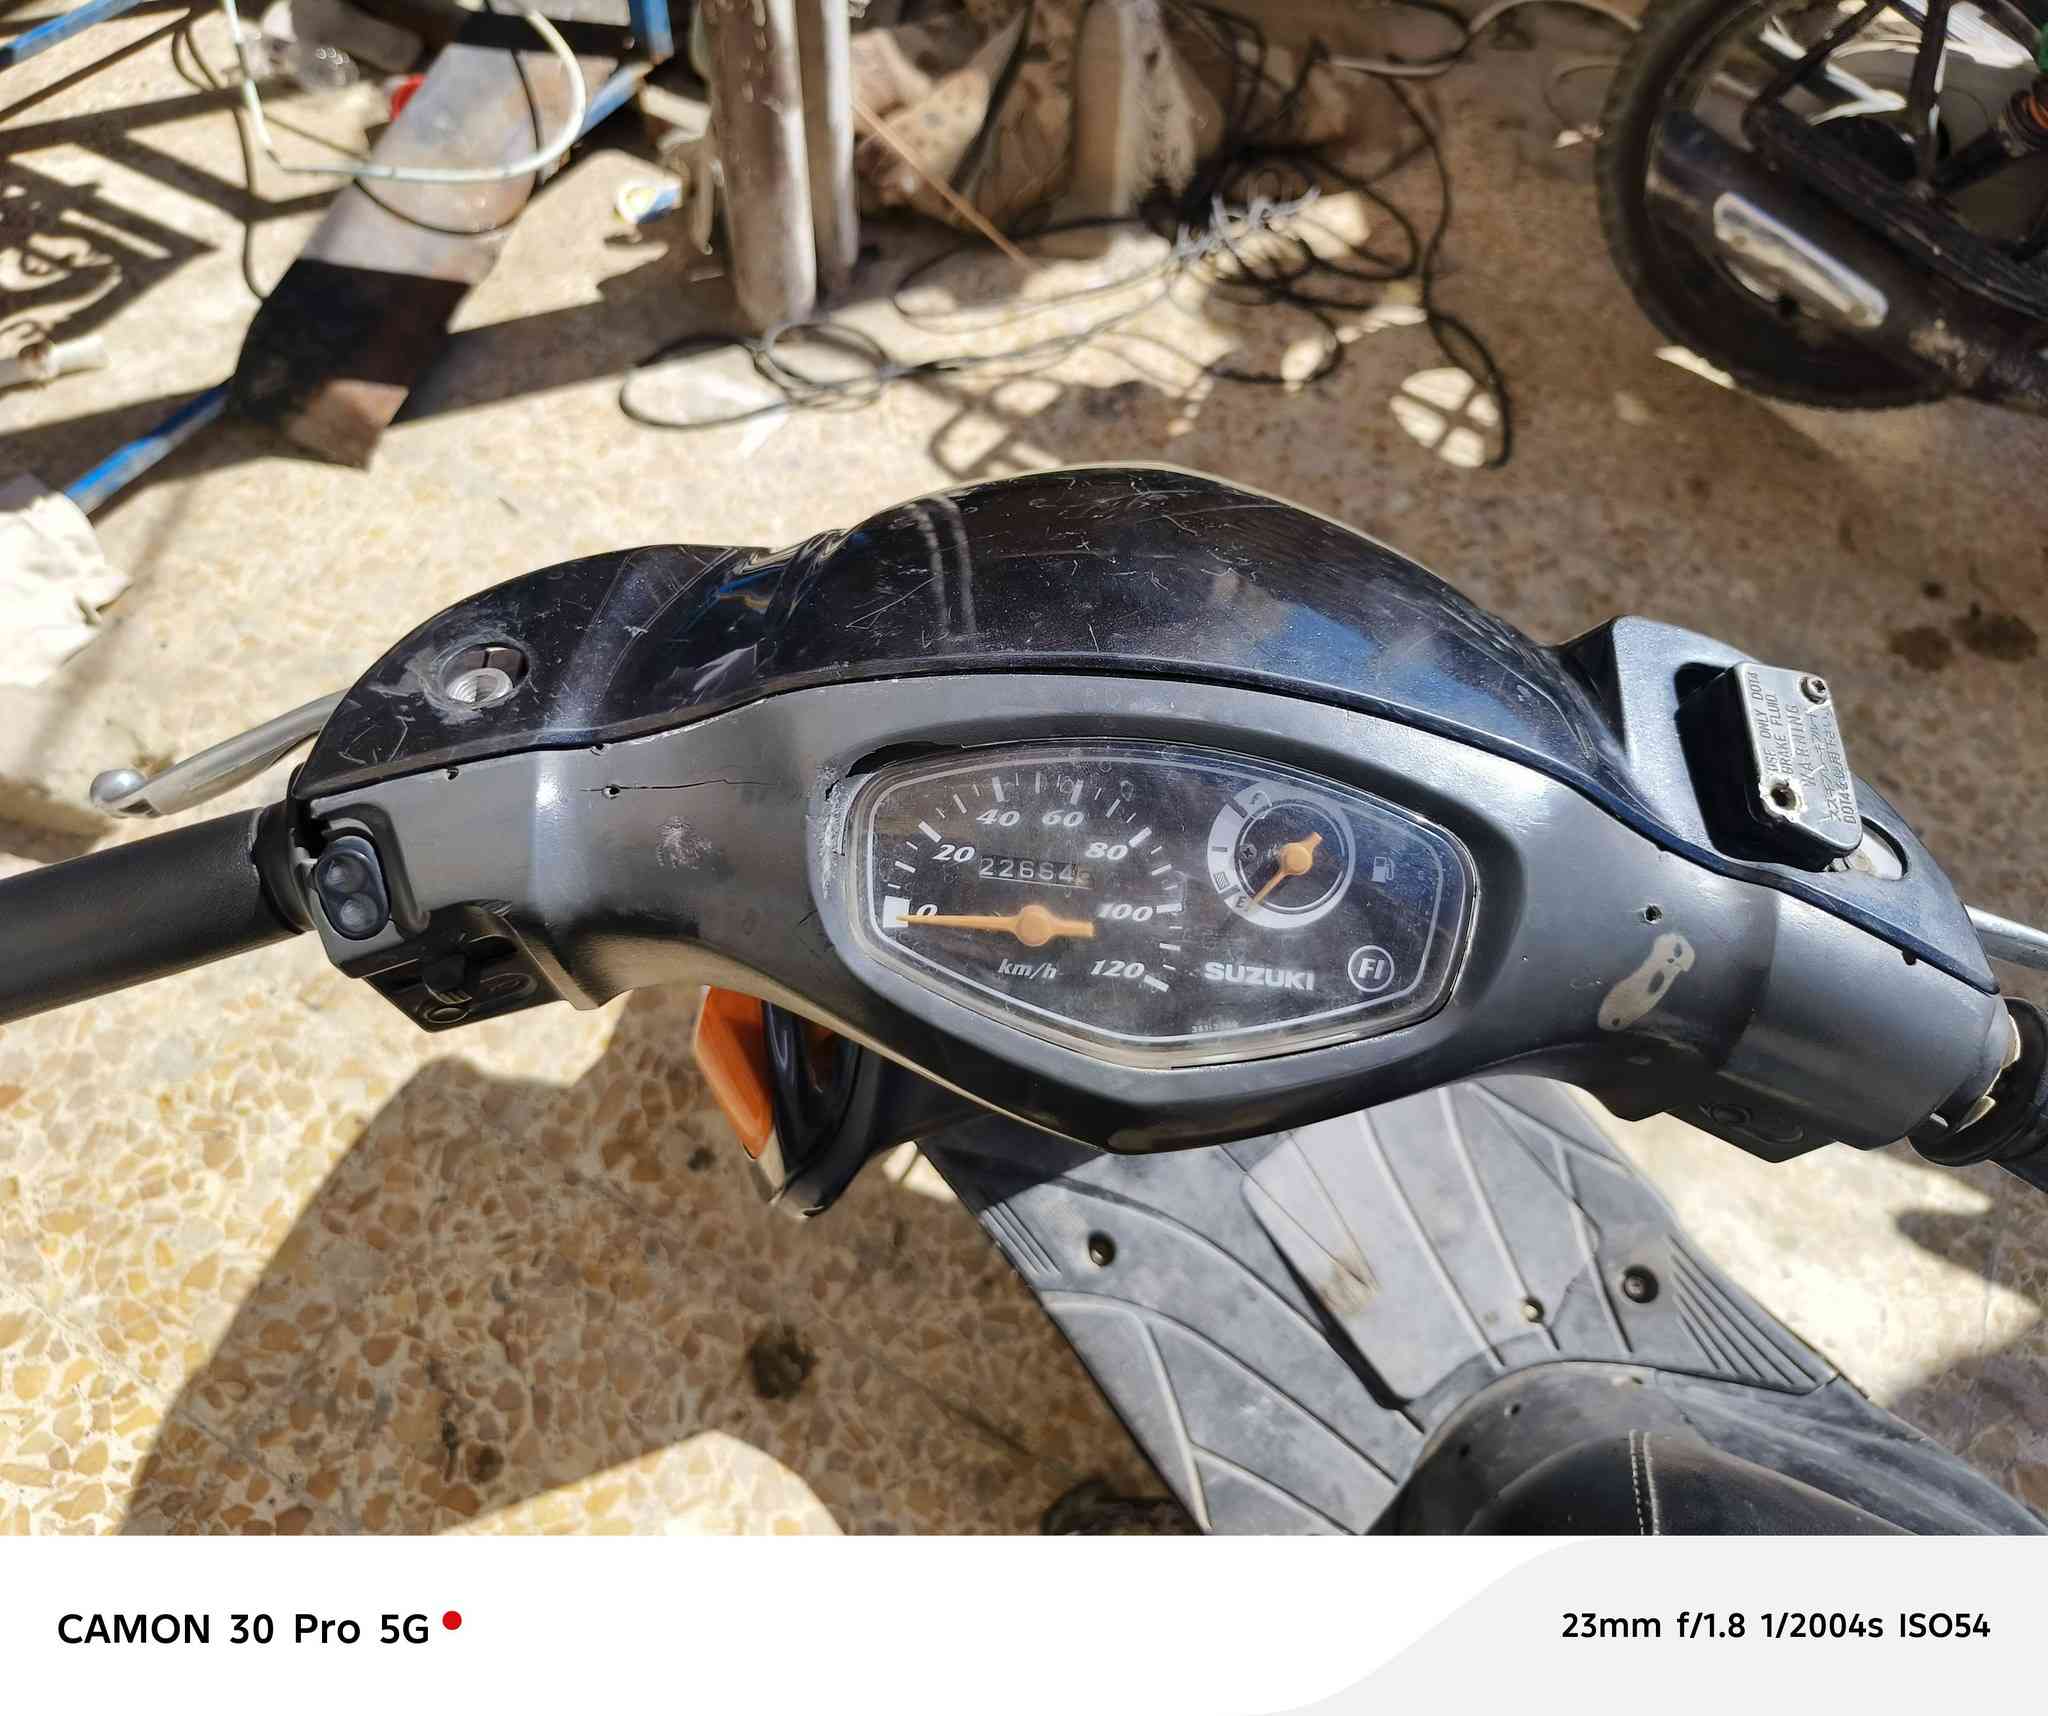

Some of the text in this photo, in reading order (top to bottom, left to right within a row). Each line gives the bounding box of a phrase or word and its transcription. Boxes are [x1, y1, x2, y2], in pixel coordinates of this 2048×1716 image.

[1748, 671, 1779, 772] USE ONLY DOT4
[1765, 694, 1793, 774] BRAKE FLUID
[1786, 704, 1817, 786] WARNING
[976, 808, 1021, 827] 40
[1042, 809, 1085, 827] 60
[932, 844, 975, 863] 20
[1085, 842, 1129, 861] 80
[917, 903, 938, 917] 0
[1098, 903, 1153, 922] 100
[998, 958, 1058, 980] km/h
[1091, 959, 1145, 978] 120
[1204, 961, 1315, 991] SUZUKI
[1357, 958, 1385, 980] FI
